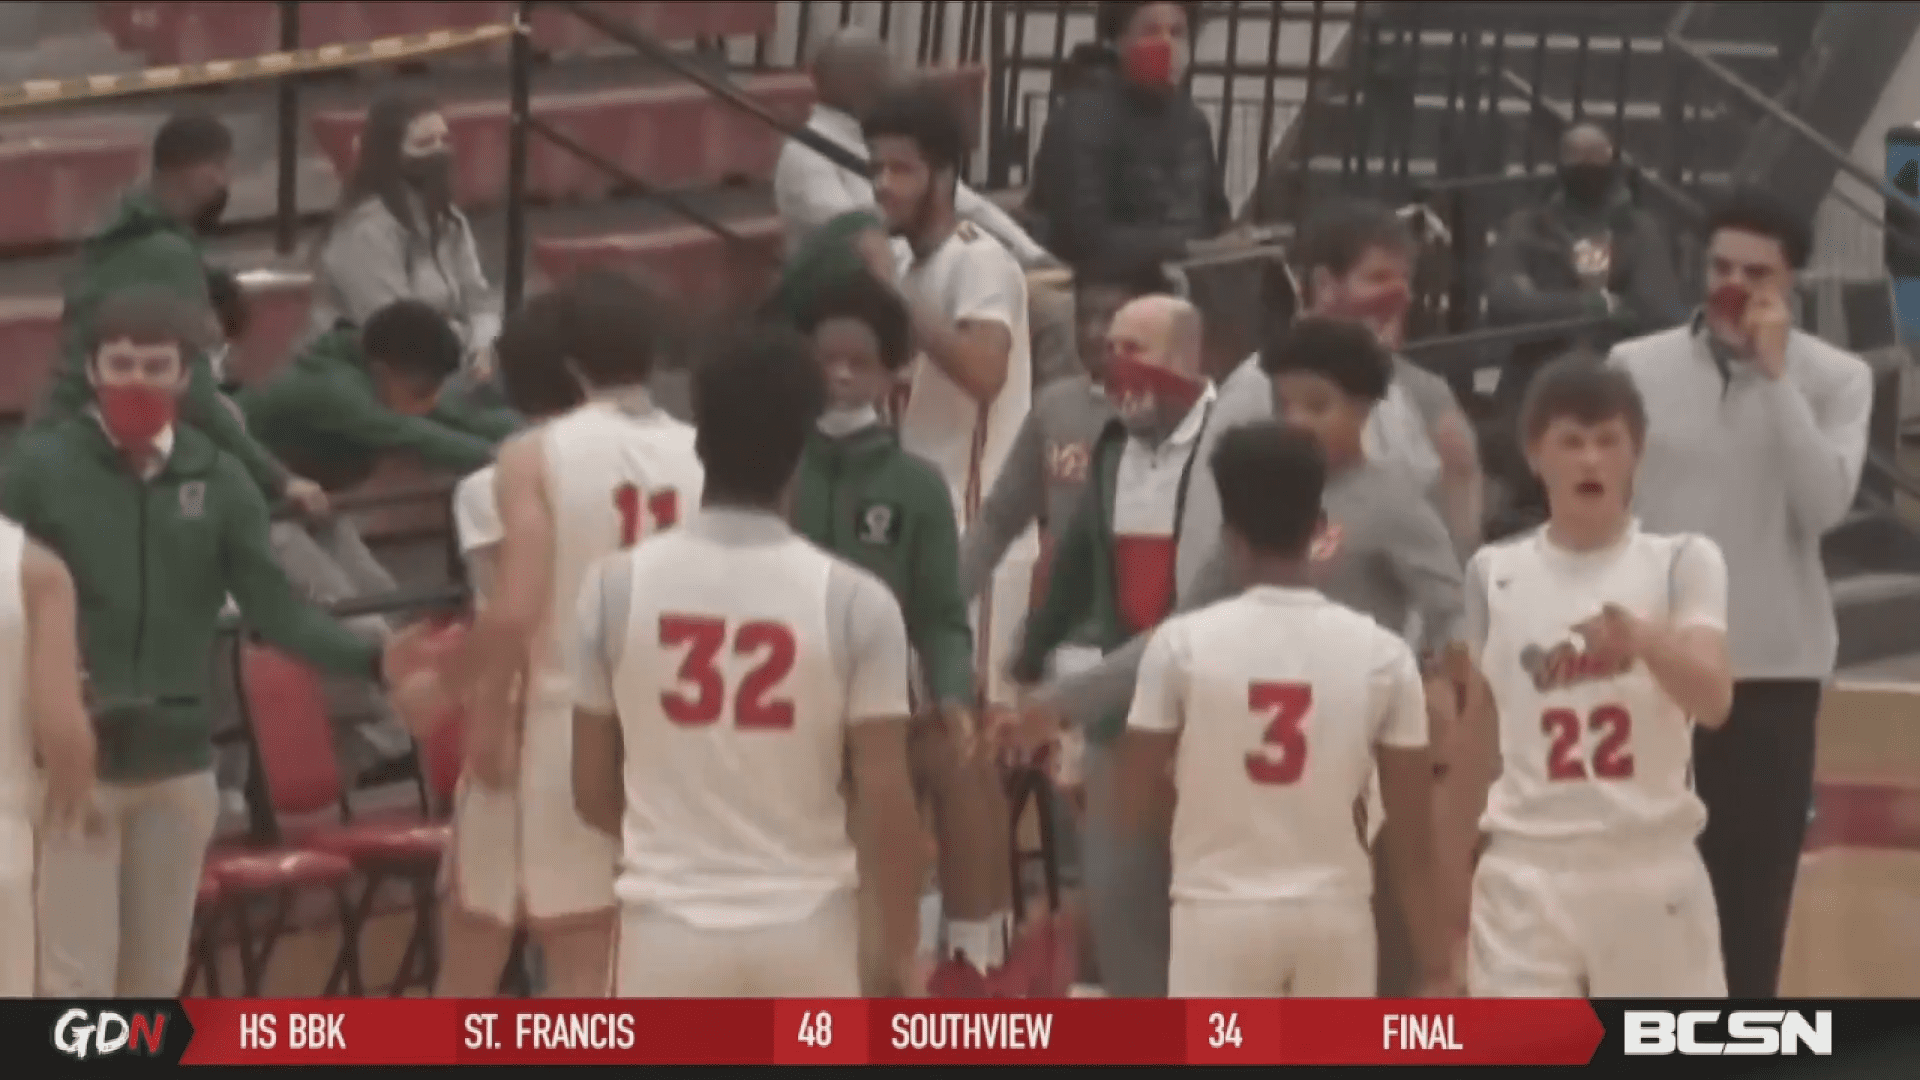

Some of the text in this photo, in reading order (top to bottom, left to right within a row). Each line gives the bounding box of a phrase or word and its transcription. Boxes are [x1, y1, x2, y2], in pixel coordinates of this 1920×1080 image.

[614, 484, 679, 548] 11
[658, 613, 797, 731] 32
[1245, 681, 1313, 786] 3
[1541, 704, 1635, 782] 22
